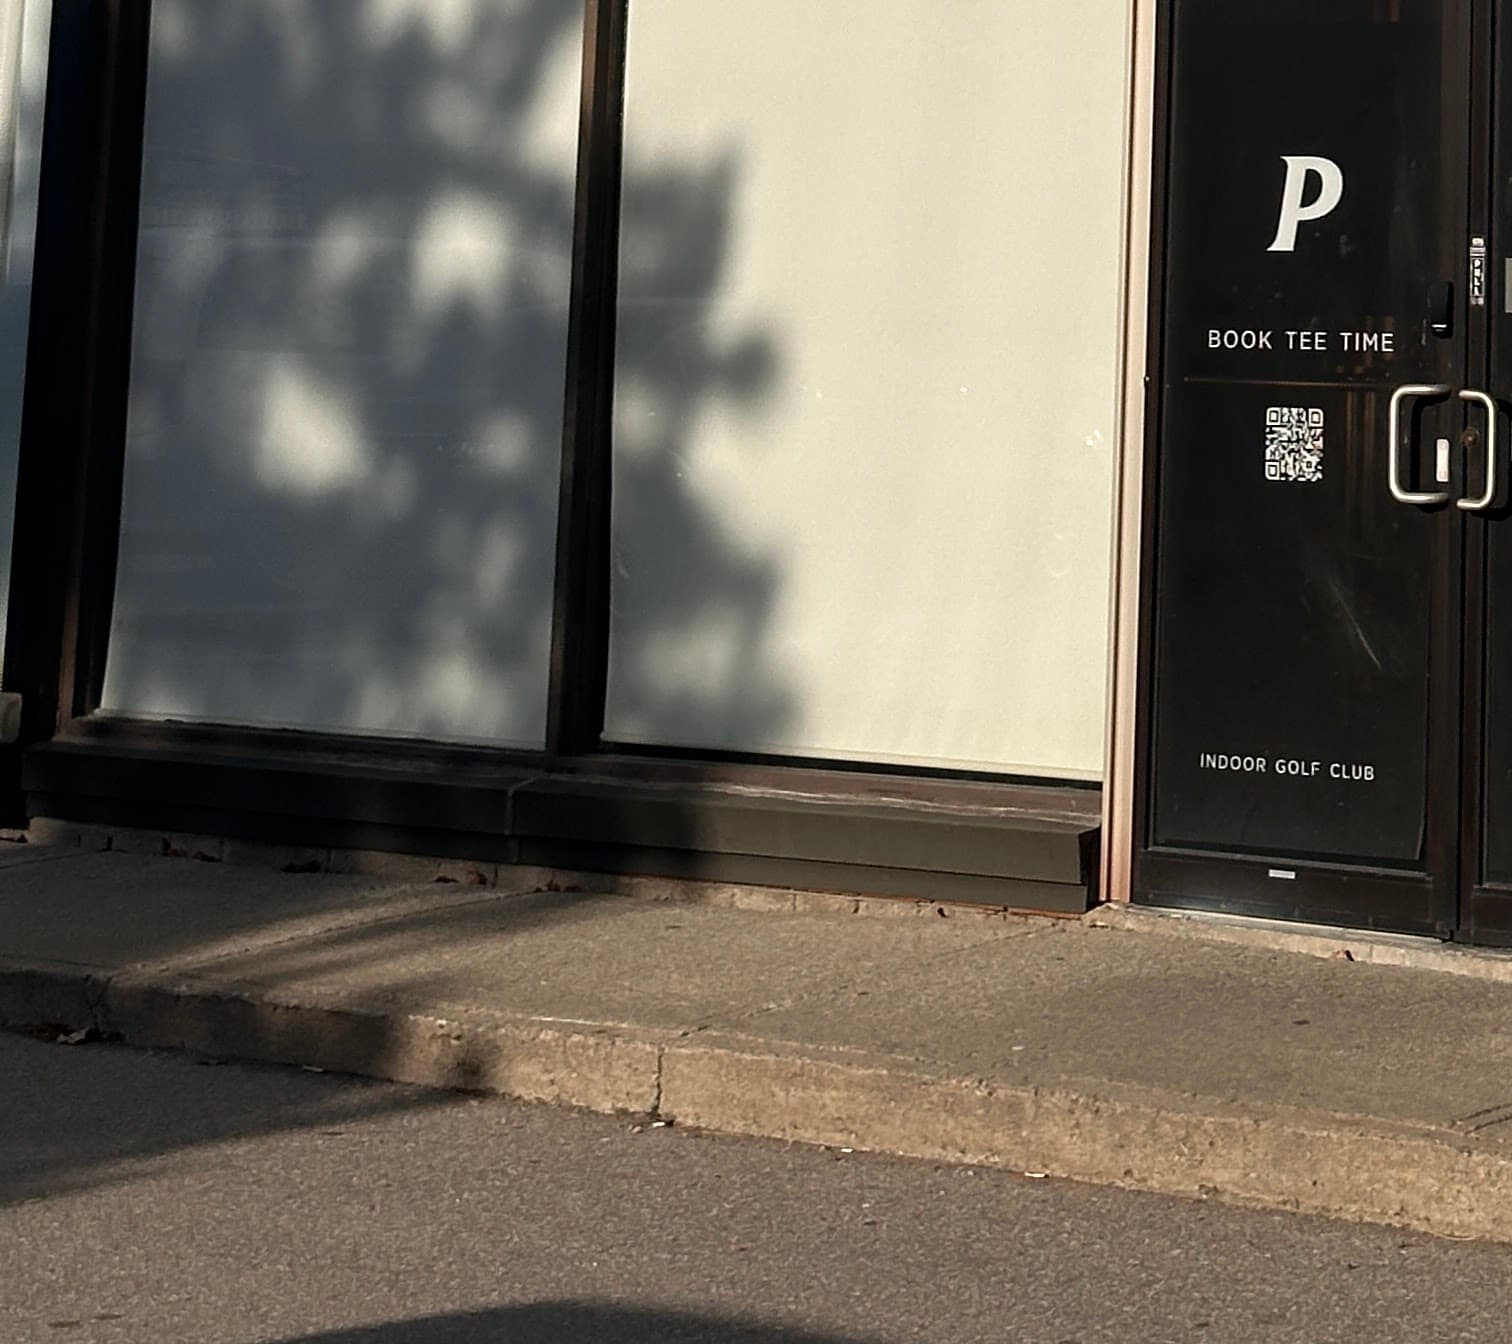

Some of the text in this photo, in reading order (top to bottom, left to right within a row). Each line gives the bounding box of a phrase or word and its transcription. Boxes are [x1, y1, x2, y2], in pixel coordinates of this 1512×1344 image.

[1267, 156, 1343, 252] P
[1208, 330, 1394, 351] BOOK TEE TIME
[1200, 754, 1375, 780] INDOOR GOLF CLUB
